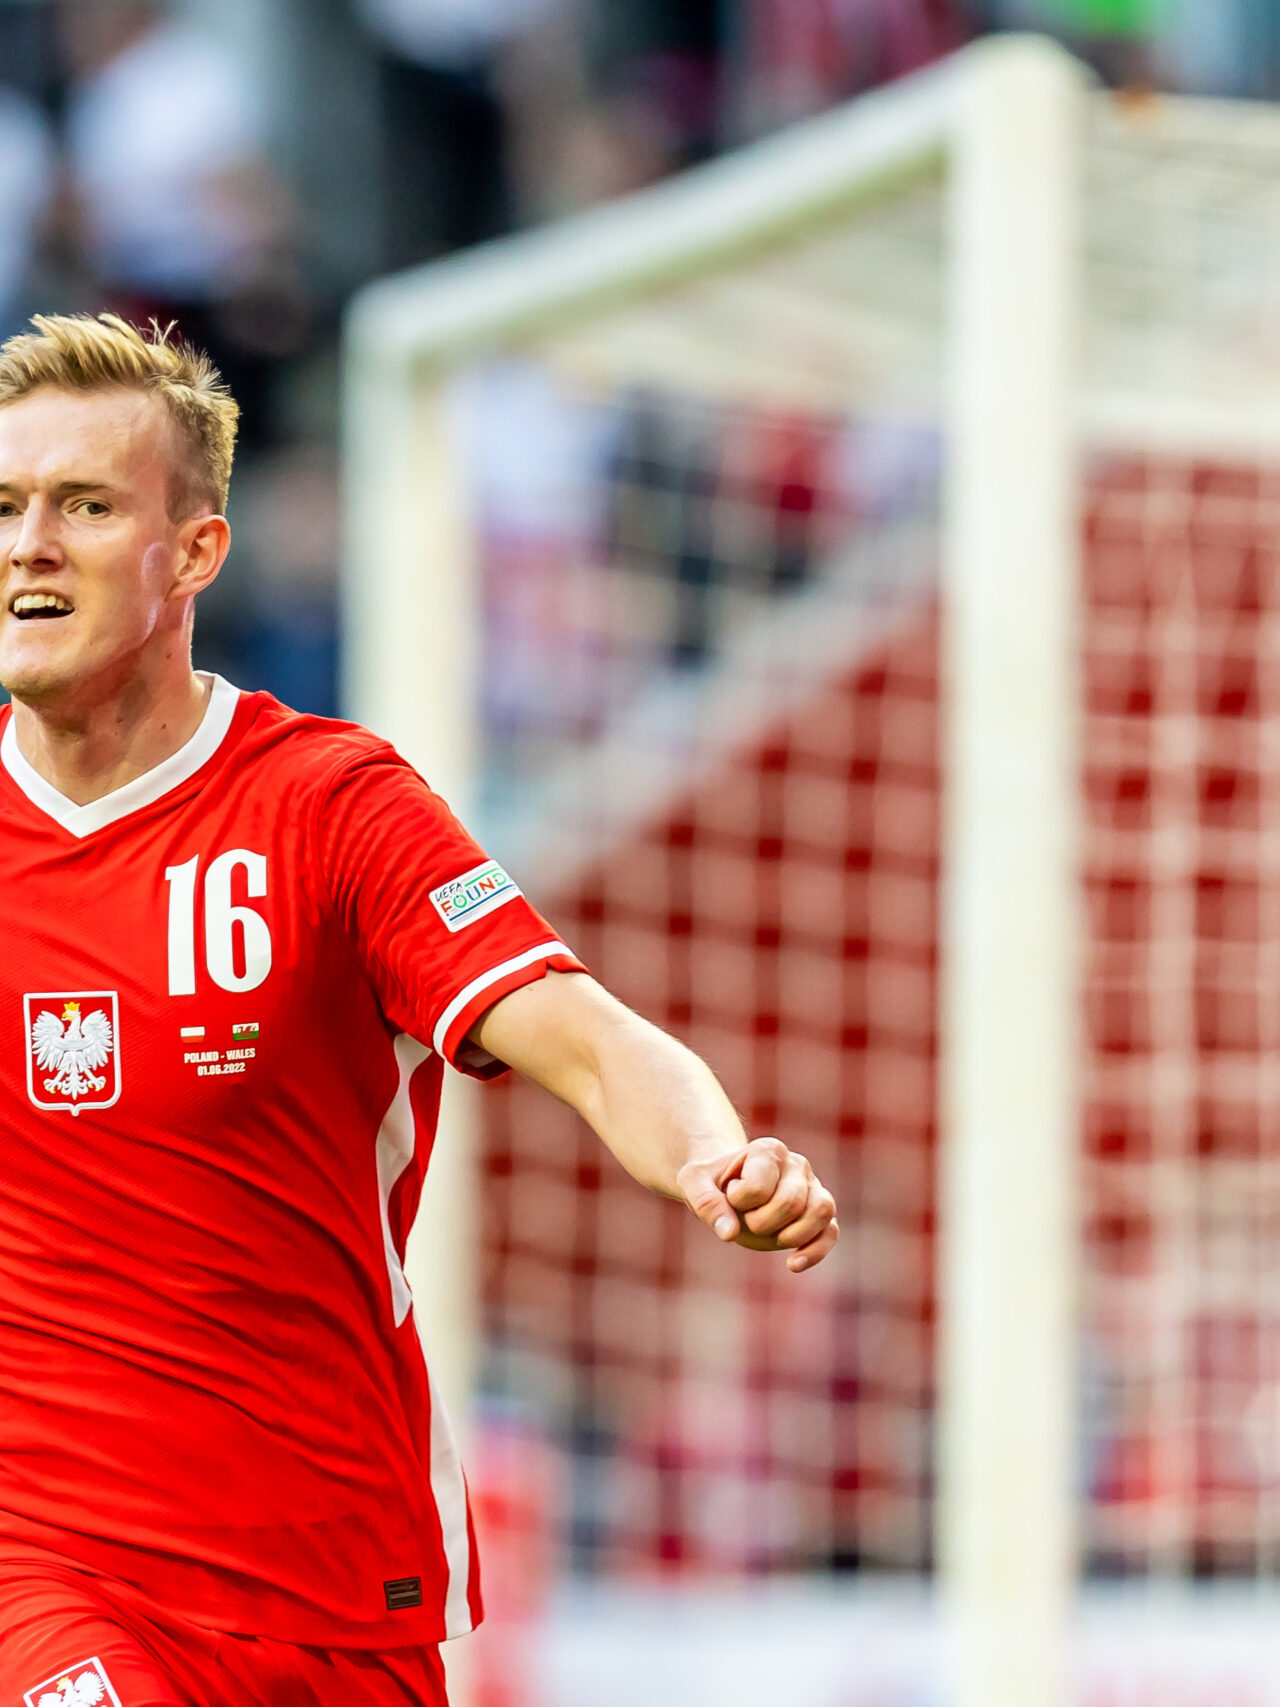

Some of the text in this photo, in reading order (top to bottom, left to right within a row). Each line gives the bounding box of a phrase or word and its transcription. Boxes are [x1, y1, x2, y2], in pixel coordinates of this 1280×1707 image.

[434, 882, 462, 902] UEFA
[165, 848, 272, 996] 16
[184, 1051, 219, 1063] POLAND
[226, 1047, 256, 1060] WALES
[197, 1062, 245, 1076] 01.06.2022
